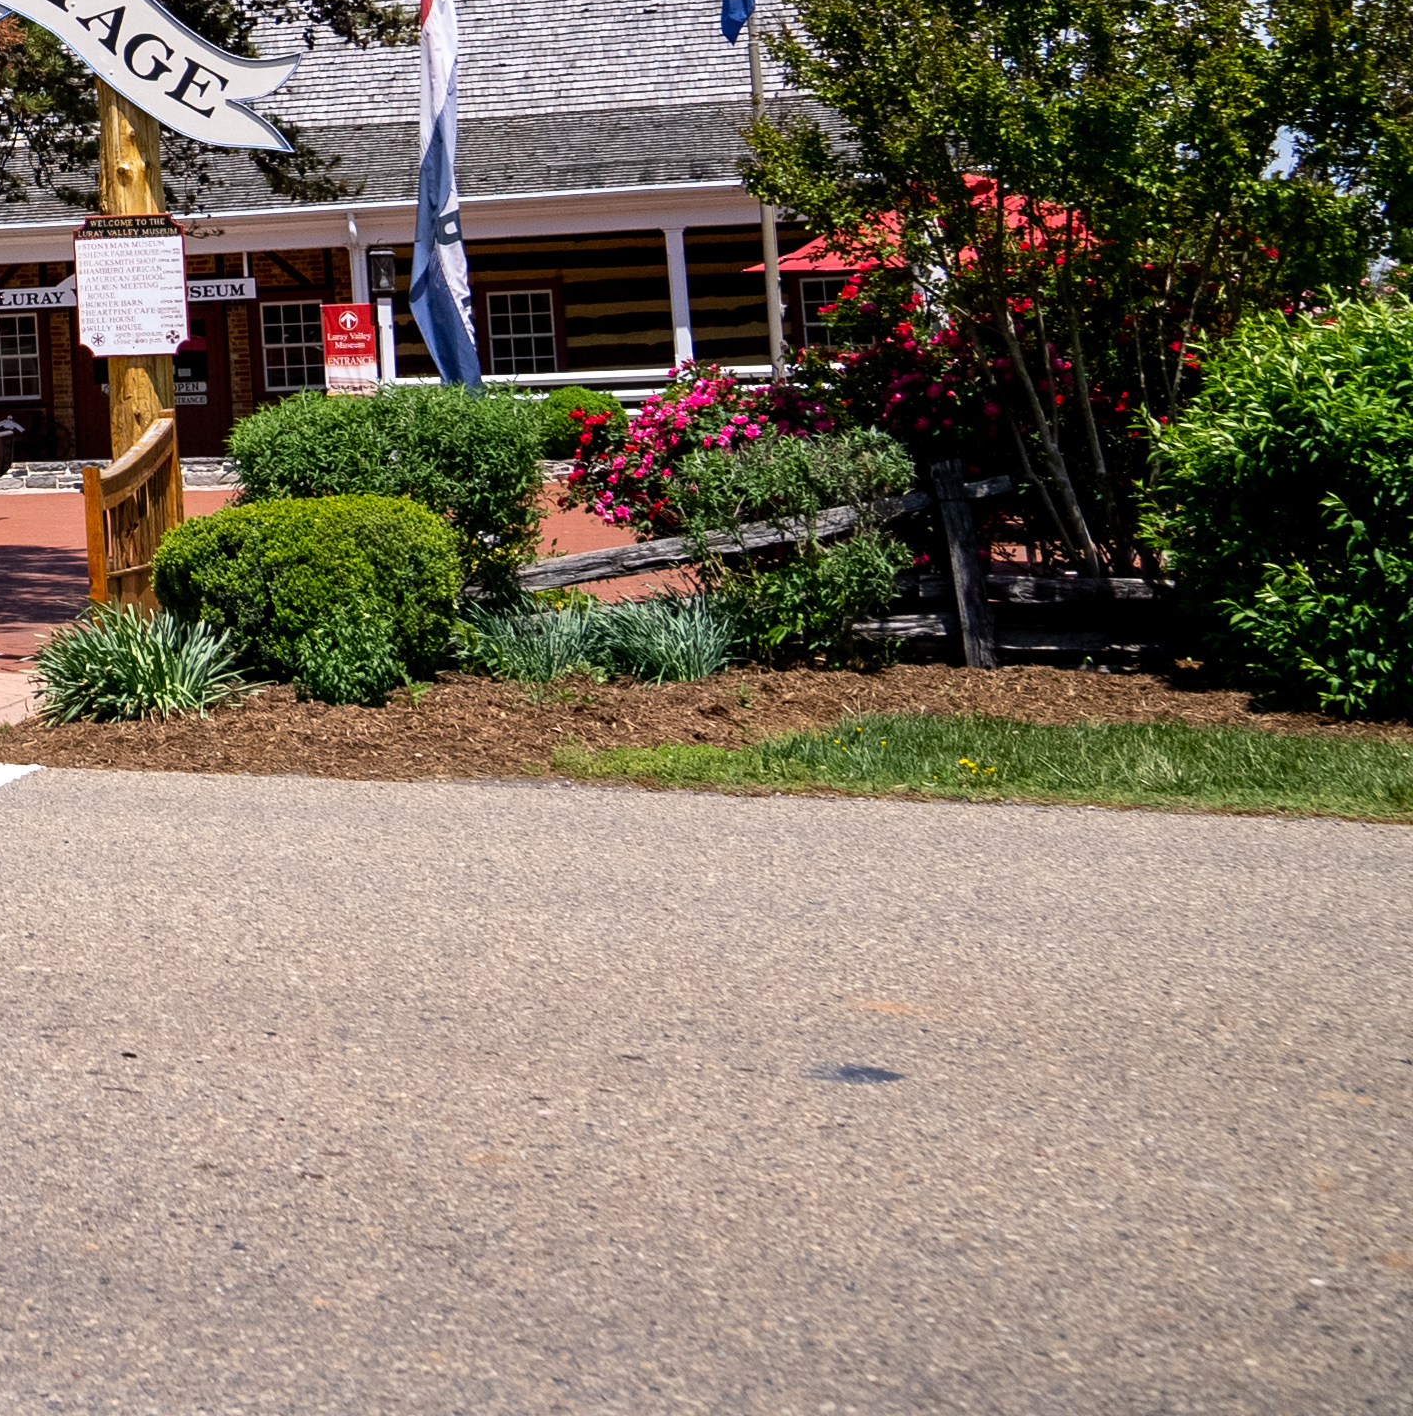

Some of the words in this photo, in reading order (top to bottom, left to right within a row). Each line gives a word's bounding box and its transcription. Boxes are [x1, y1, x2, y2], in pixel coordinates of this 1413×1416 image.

[90, 218, 133, 227] WELCOME
[136, 218, 147, 226] TO
[149, 217, 165, 225] THE
[78, 229, 104, 238] LURAY
[107, 228, 139, 237] VALLEY
[142, 227, 178, 236] MUSEUM
[82, 241, 130, 250] STONYMAN
[132, 240, 165, 248] MUSEUM
[83, 250, 109, 259] SHENK
[111, 249, 133, 258] FARM
[135, 248, 160, 256] HOUSE
[83, 258, 134, 268] BLACKSMITH
[136, 257, 156, 265] SHOP
[83, 266, 124, 275] HAMBURG
[126, 265, 162, 274] AFRICAN
[86, 274, 130, 284] AMERICAN
[132, 273, 165, 281] SCHOOL
[84, 284, 100, 292] ELK
[101, 283, 119, 291] RUN
[121, 281, 159, 290] MEETING
[187, 283, 246, 298] SEUM
[87, 292, 115, 300] HOUSE
[85, 300, 119, 308] BURNER
[121, 299, 144, 307] BARN
[327, 332, 348, 341] Luray
[349, 331, 372, 341] Valley
[334, 341, 366, 349] Museum
[327, 355, 374, 365] ENTRANCE
